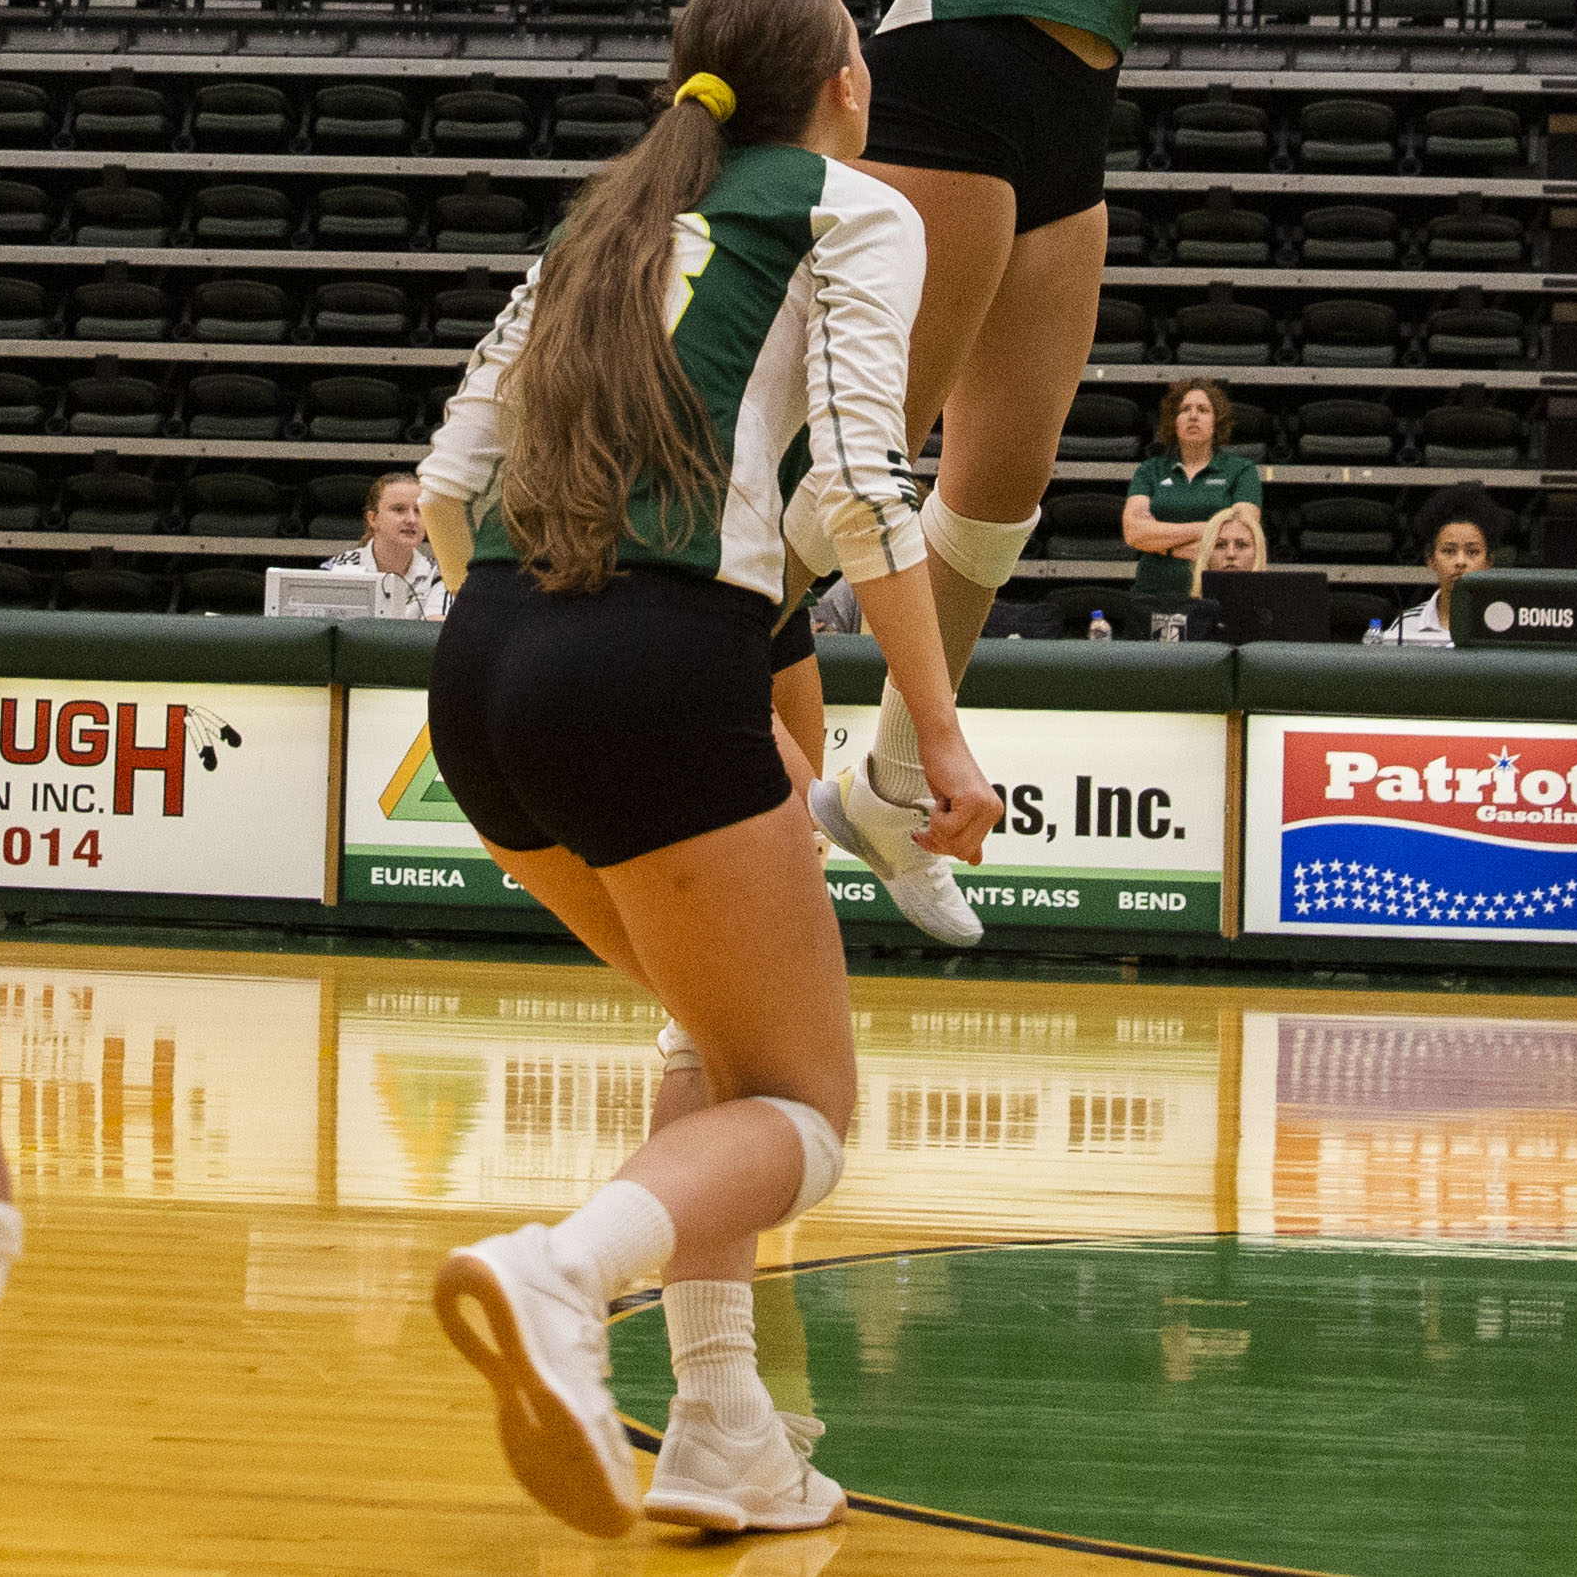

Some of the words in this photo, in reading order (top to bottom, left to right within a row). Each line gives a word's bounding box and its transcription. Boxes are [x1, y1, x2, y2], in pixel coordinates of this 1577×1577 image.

[1518, 607, 1573, 627] BONUS
[32, 783, 103, 813] INC.
[1076, 776, 1185, 839] Inc.
[371, 867, 465, 887] EUREKA
[1022, 888, 1079, 908] PASS
[1119, 891, 1186, 911] BEND
